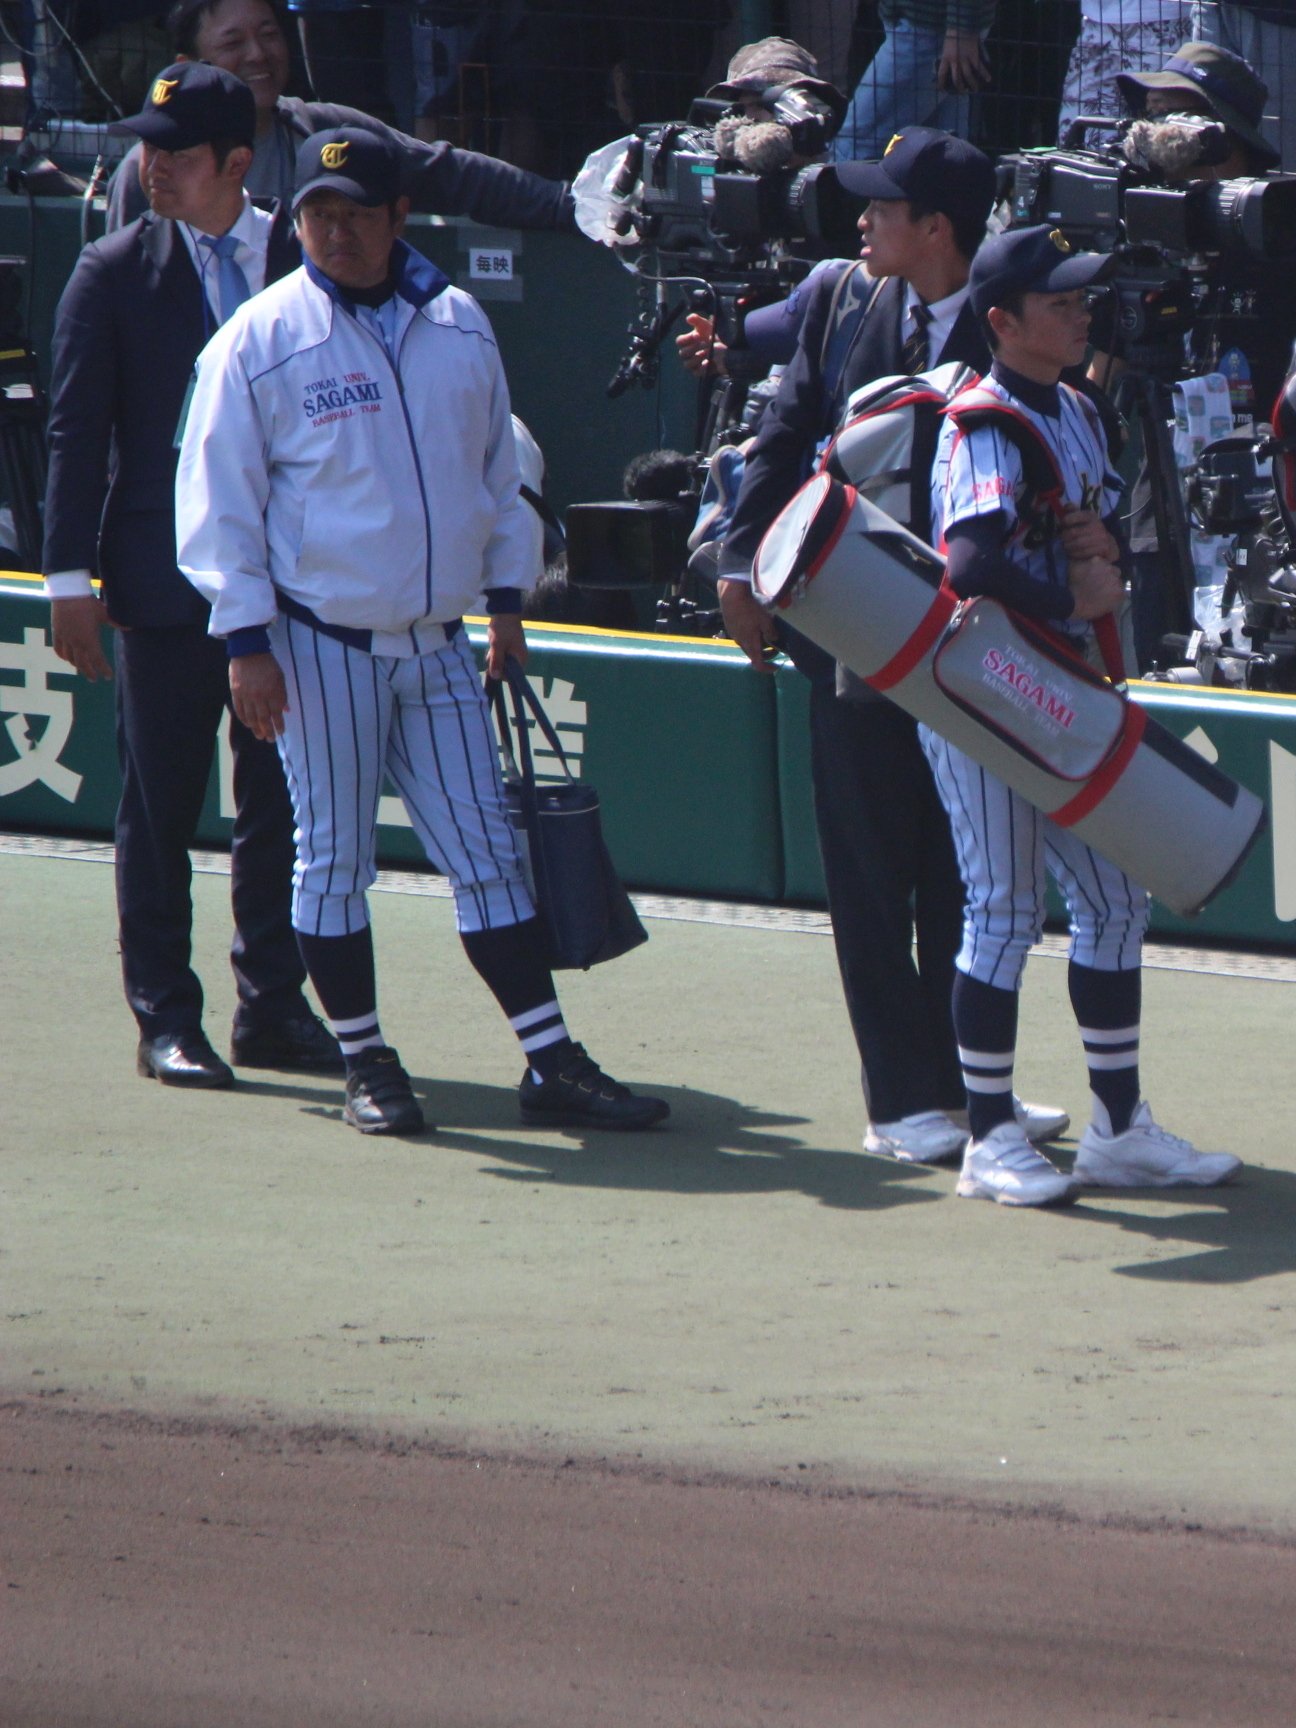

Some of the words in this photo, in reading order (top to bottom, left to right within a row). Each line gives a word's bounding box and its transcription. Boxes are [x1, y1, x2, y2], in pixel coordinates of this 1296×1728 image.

[476, 255, 509, 274] 毎映
[304, 377, 338, 396] TOKAI
[303, 382, 383, 418] SAGAMI
[312, 408, 356, 428] BASEBALL
[983, 648, 1077, 730] SAGAMI
